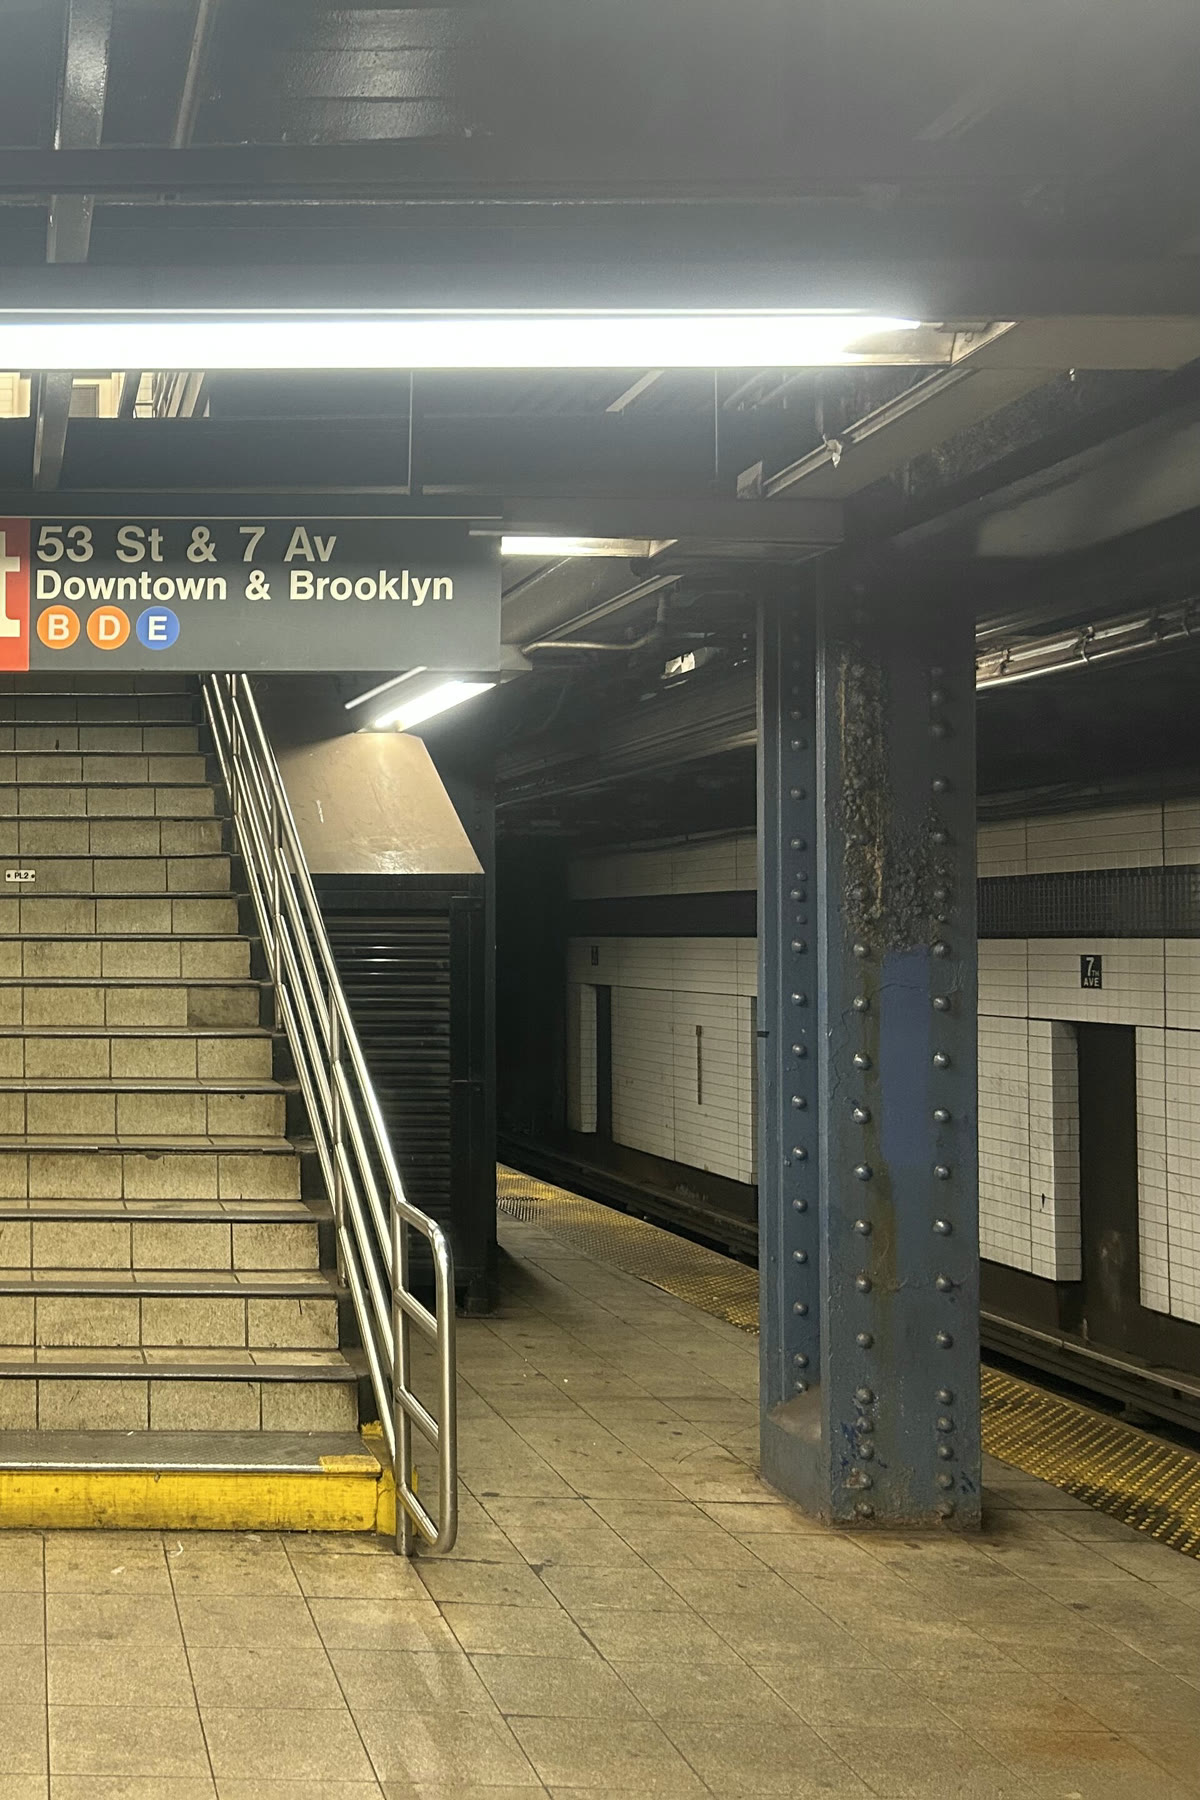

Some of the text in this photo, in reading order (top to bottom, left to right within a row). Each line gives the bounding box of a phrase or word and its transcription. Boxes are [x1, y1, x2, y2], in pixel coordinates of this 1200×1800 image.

[36, 525, 337, 563] 53 St & 7 Av
[36, 569, 454, 607] Downtown & Brooklyn
[47, 613, 168, 641] B D E
[14, 871, 29, 880] PL2
[1083, 977, 1100, 987] AVE
